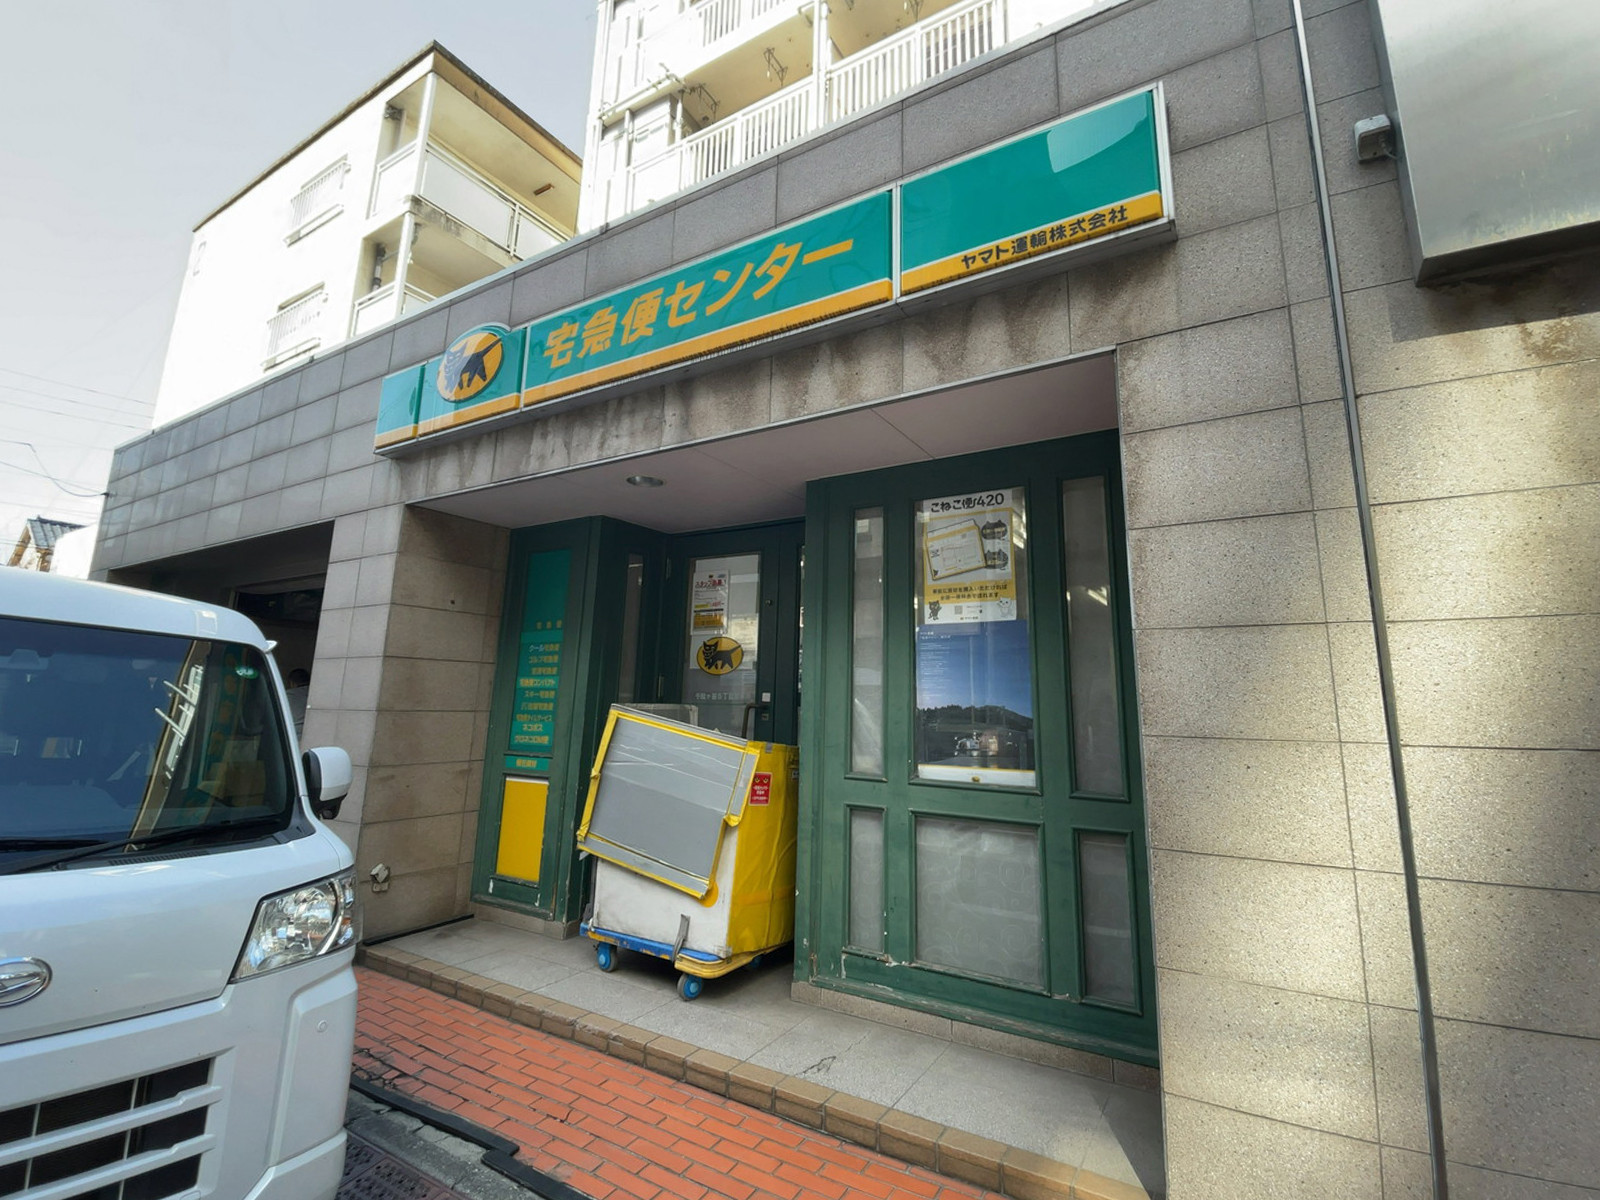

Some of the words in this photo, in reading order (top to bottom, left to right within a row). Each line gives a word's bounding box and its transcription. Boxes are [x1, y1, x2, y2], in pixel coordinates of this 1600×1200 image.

[962, 205, 1129, 269] ヤマト運輸株式会社
[543, 238, 854, 369] 宅急便センター
[931, 493, 1005, 513] こねこ便420
